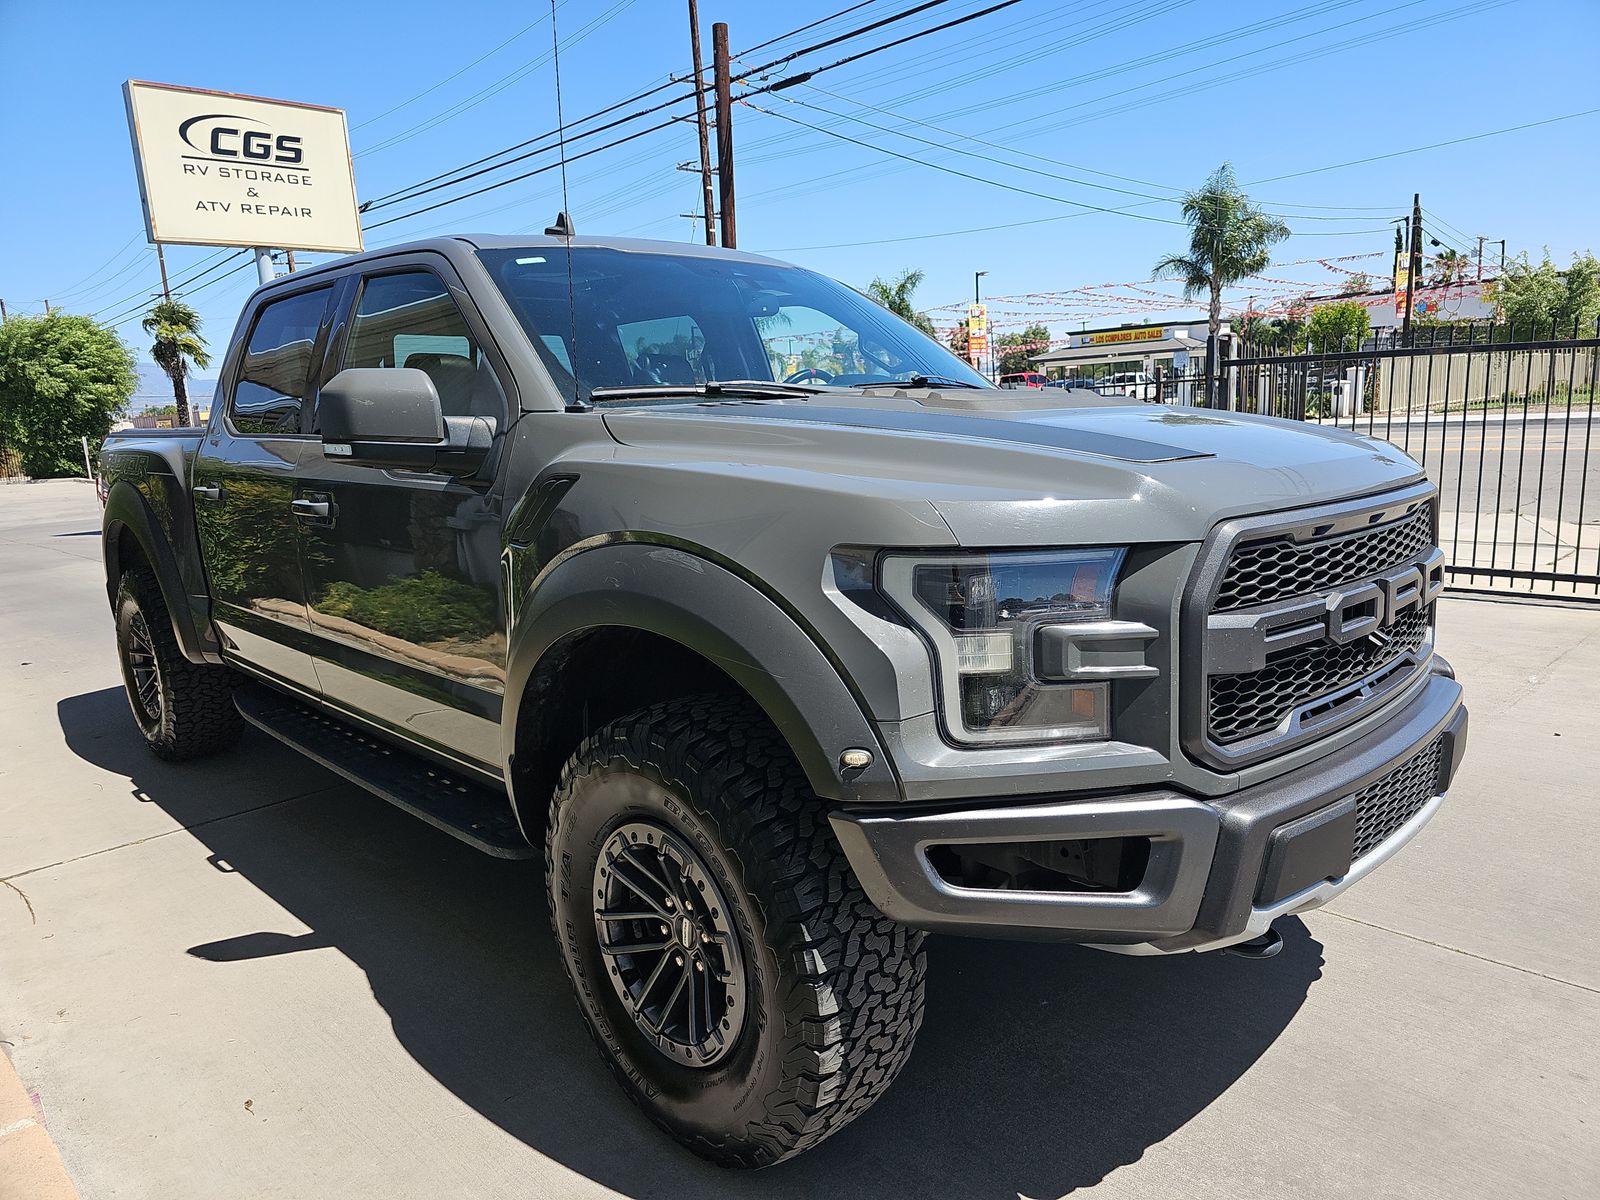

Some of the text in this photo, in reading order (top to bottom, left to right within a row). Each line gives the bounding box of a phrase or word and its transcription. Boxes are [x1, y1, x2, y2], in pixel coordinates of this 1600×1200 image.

[210, 127, 304, 165] CGS
[183, 164, 313, 186] RV STORAGE
[246, 187, 259, 198] &
[195, 200, 313, 218] ATV REPAIR
[1207, 546, 1446, 676] FORD
